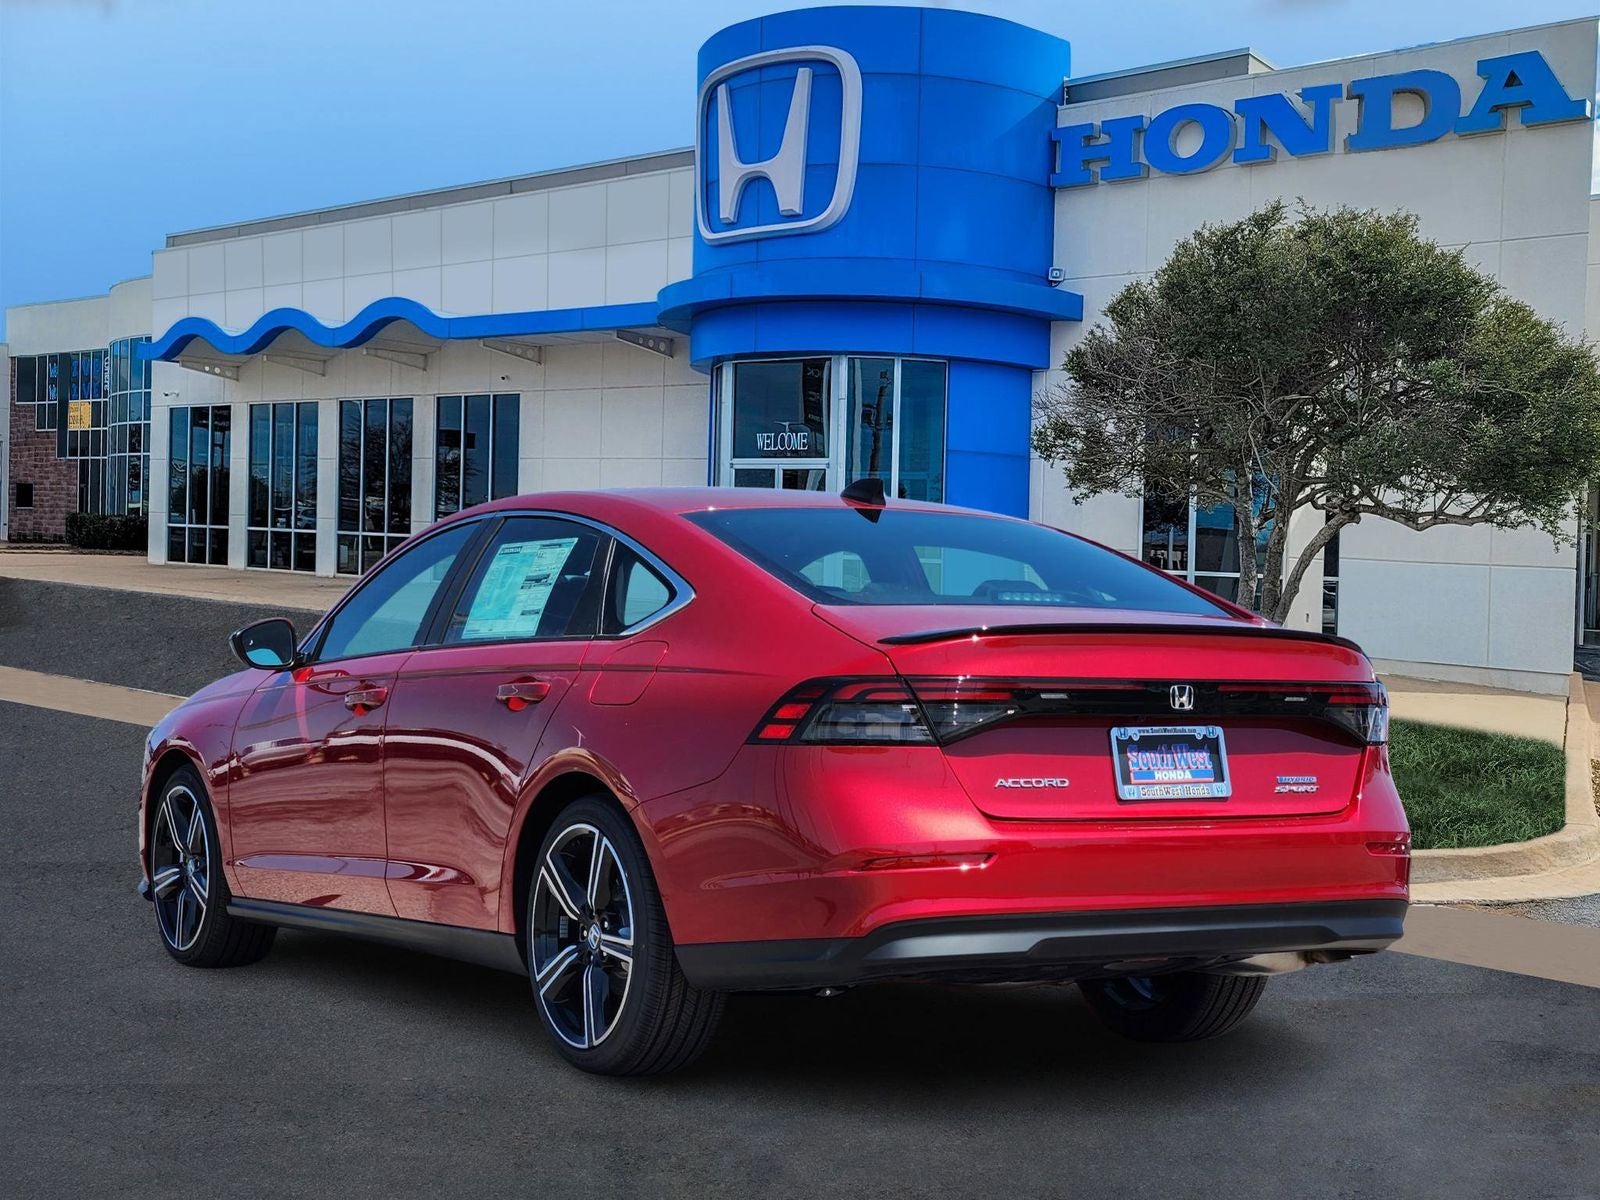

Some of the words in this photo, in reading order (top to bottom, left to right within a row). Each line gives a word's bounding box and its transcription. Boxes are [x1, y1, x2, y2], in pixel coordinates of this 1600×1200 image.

[1050, 50, 1592, 188] HONDA
[756, 432, 808, 451] WELCOME
[1154, 769, 1193, 780] HONDA
[994, 778, 1070, 789] ACCORD
[1140, 786, 1183, 797] SouthWest
[1184, 785, 1211, 796] Honda
